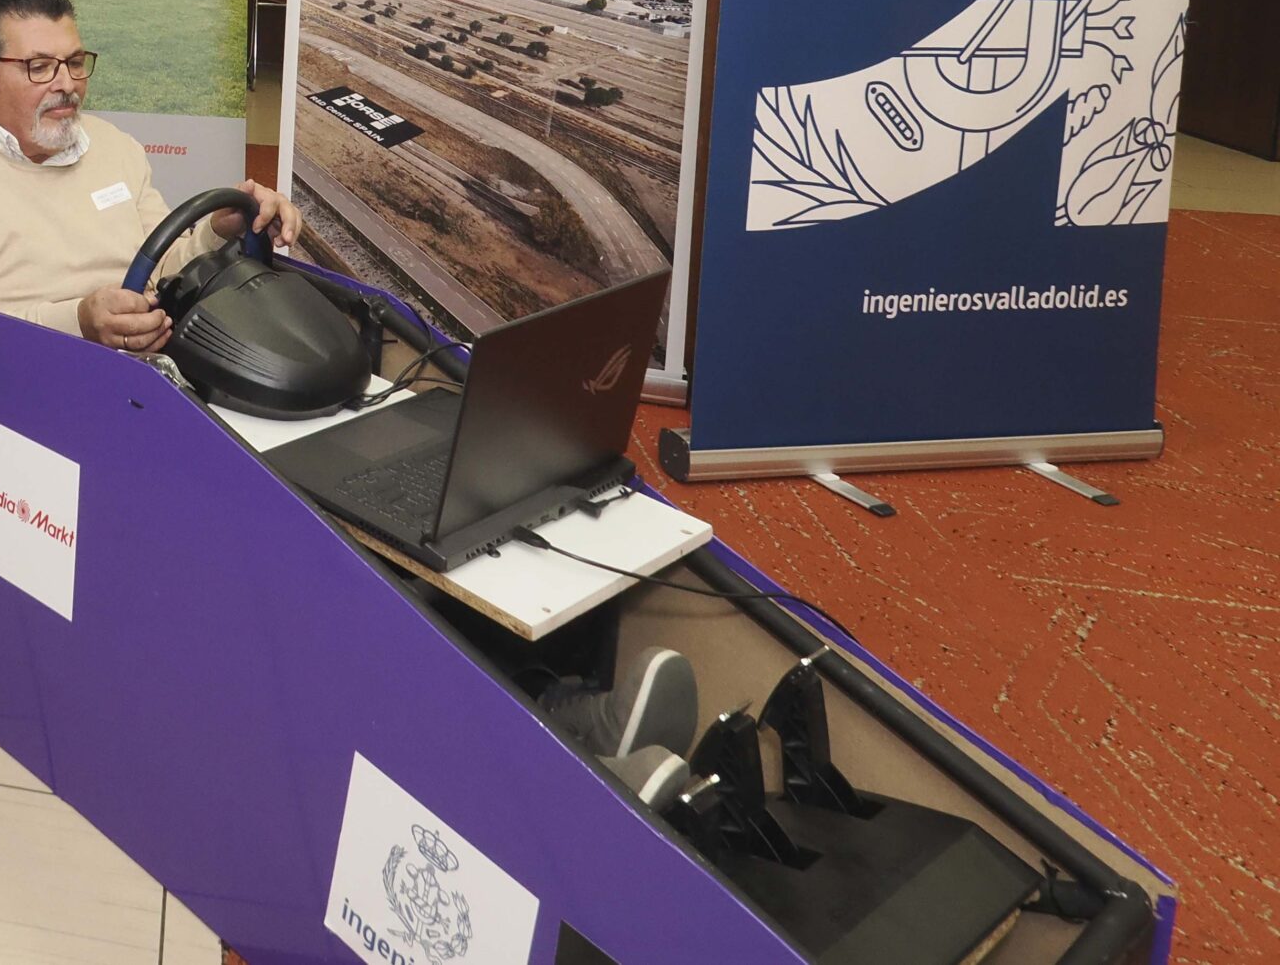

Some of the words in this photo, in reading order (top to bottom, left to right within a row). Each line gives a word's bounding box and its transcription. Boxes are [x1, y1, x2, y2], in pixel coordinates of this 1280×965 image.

[326, 105, 354, 123] Center
[353, 122, 385, 142] SPAIN
[339, 95, 397, 127] HORSE
[862, 284, 1129, 319] ingenierosvalladolid.es
[30, 510, 75, 547] Markt
